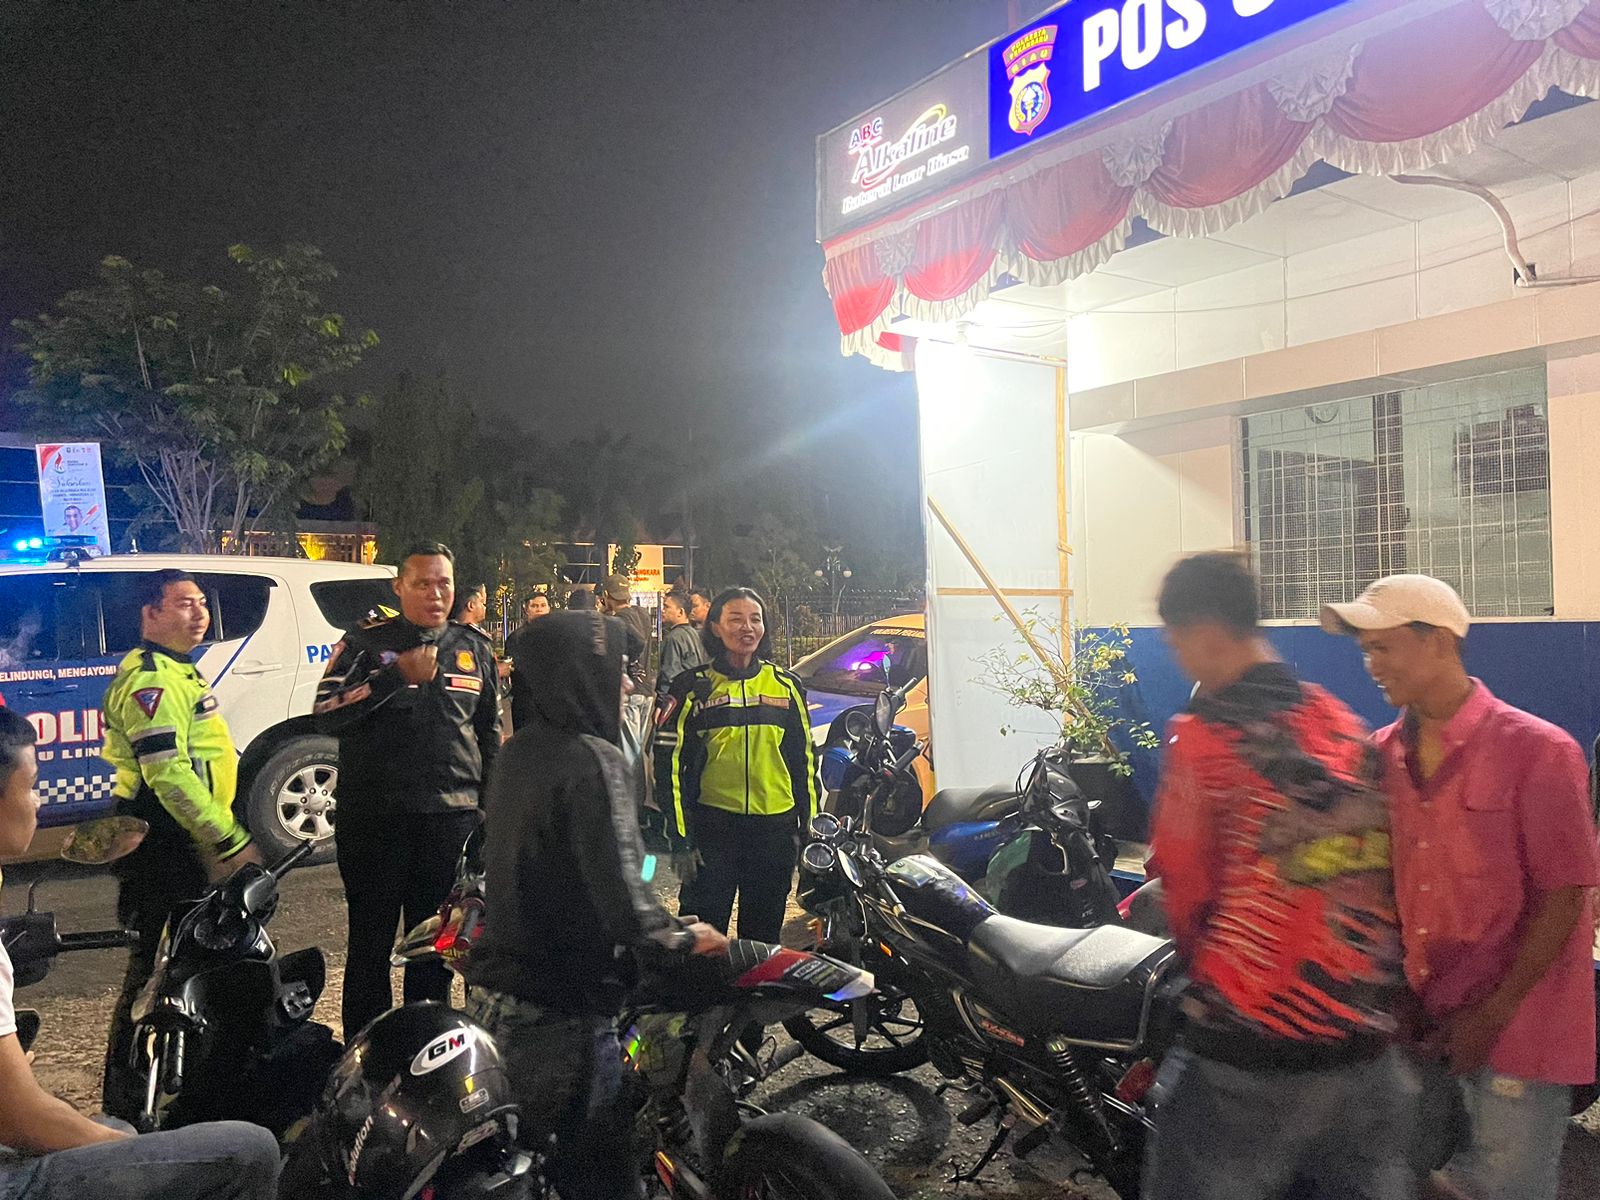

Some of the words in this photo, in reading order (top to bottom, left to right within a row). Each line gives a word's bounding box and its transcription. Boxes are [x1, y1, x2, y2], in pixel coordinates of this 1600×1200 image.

[1083, 0, 1207, 92] POS
[1011, 49, 1048, 74] RIAU
[849, 117, 883, 149] ABC
[851, 114, 957, 183] Alkaline
[306, 644, 335, 664] PA
[58, 665, 117, 678] MENGAYOMI
[25, 709, 105, 745] OLI
[427, 1033, 466, 1062] GM
